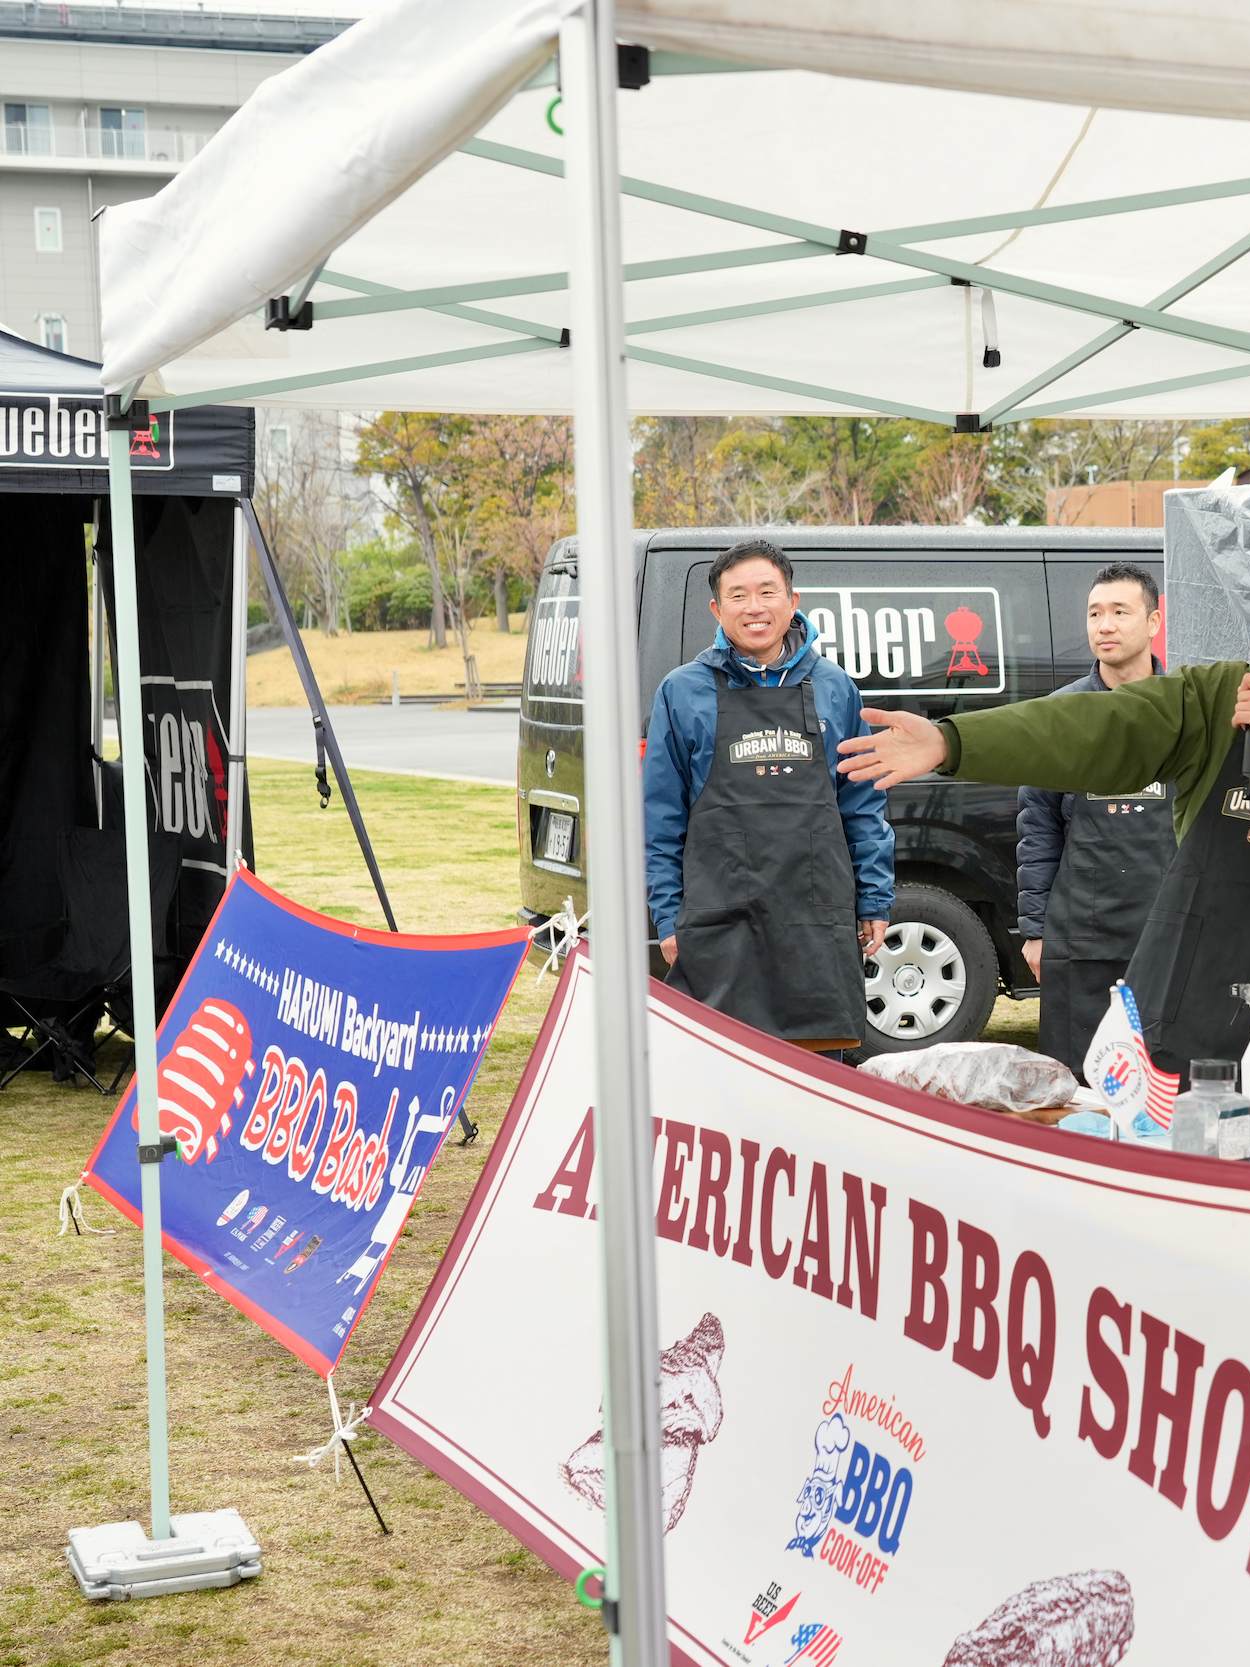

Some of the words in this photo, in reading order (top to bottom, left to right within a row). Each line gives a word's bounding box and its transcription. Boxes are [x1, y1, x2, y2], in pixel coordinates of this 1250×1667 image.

[532, 601, 579, 686] weber
[805, 590, 936, 679] eber
[734, 738, 778, 759] URBAN
[784, 738, 809, 757] BBQ
[277, 967, 344, 1047] HARUMI
[341, 994, 421, 1078] Backyard
[240, 1044, 328, 1182] BBQ
[310, 1080, 400, 1213] Bash
[533, 1106, 887, 1320] AERICAN
[903, 1196, 1057, 1440] BBQ
[822, 1363, 927, 1462] American
[834, 1440, 914, 1557] BBQ
[752, 1593, 778, 1618] BEEF
[819, 1527, 890, 1595] COOK-OFF
